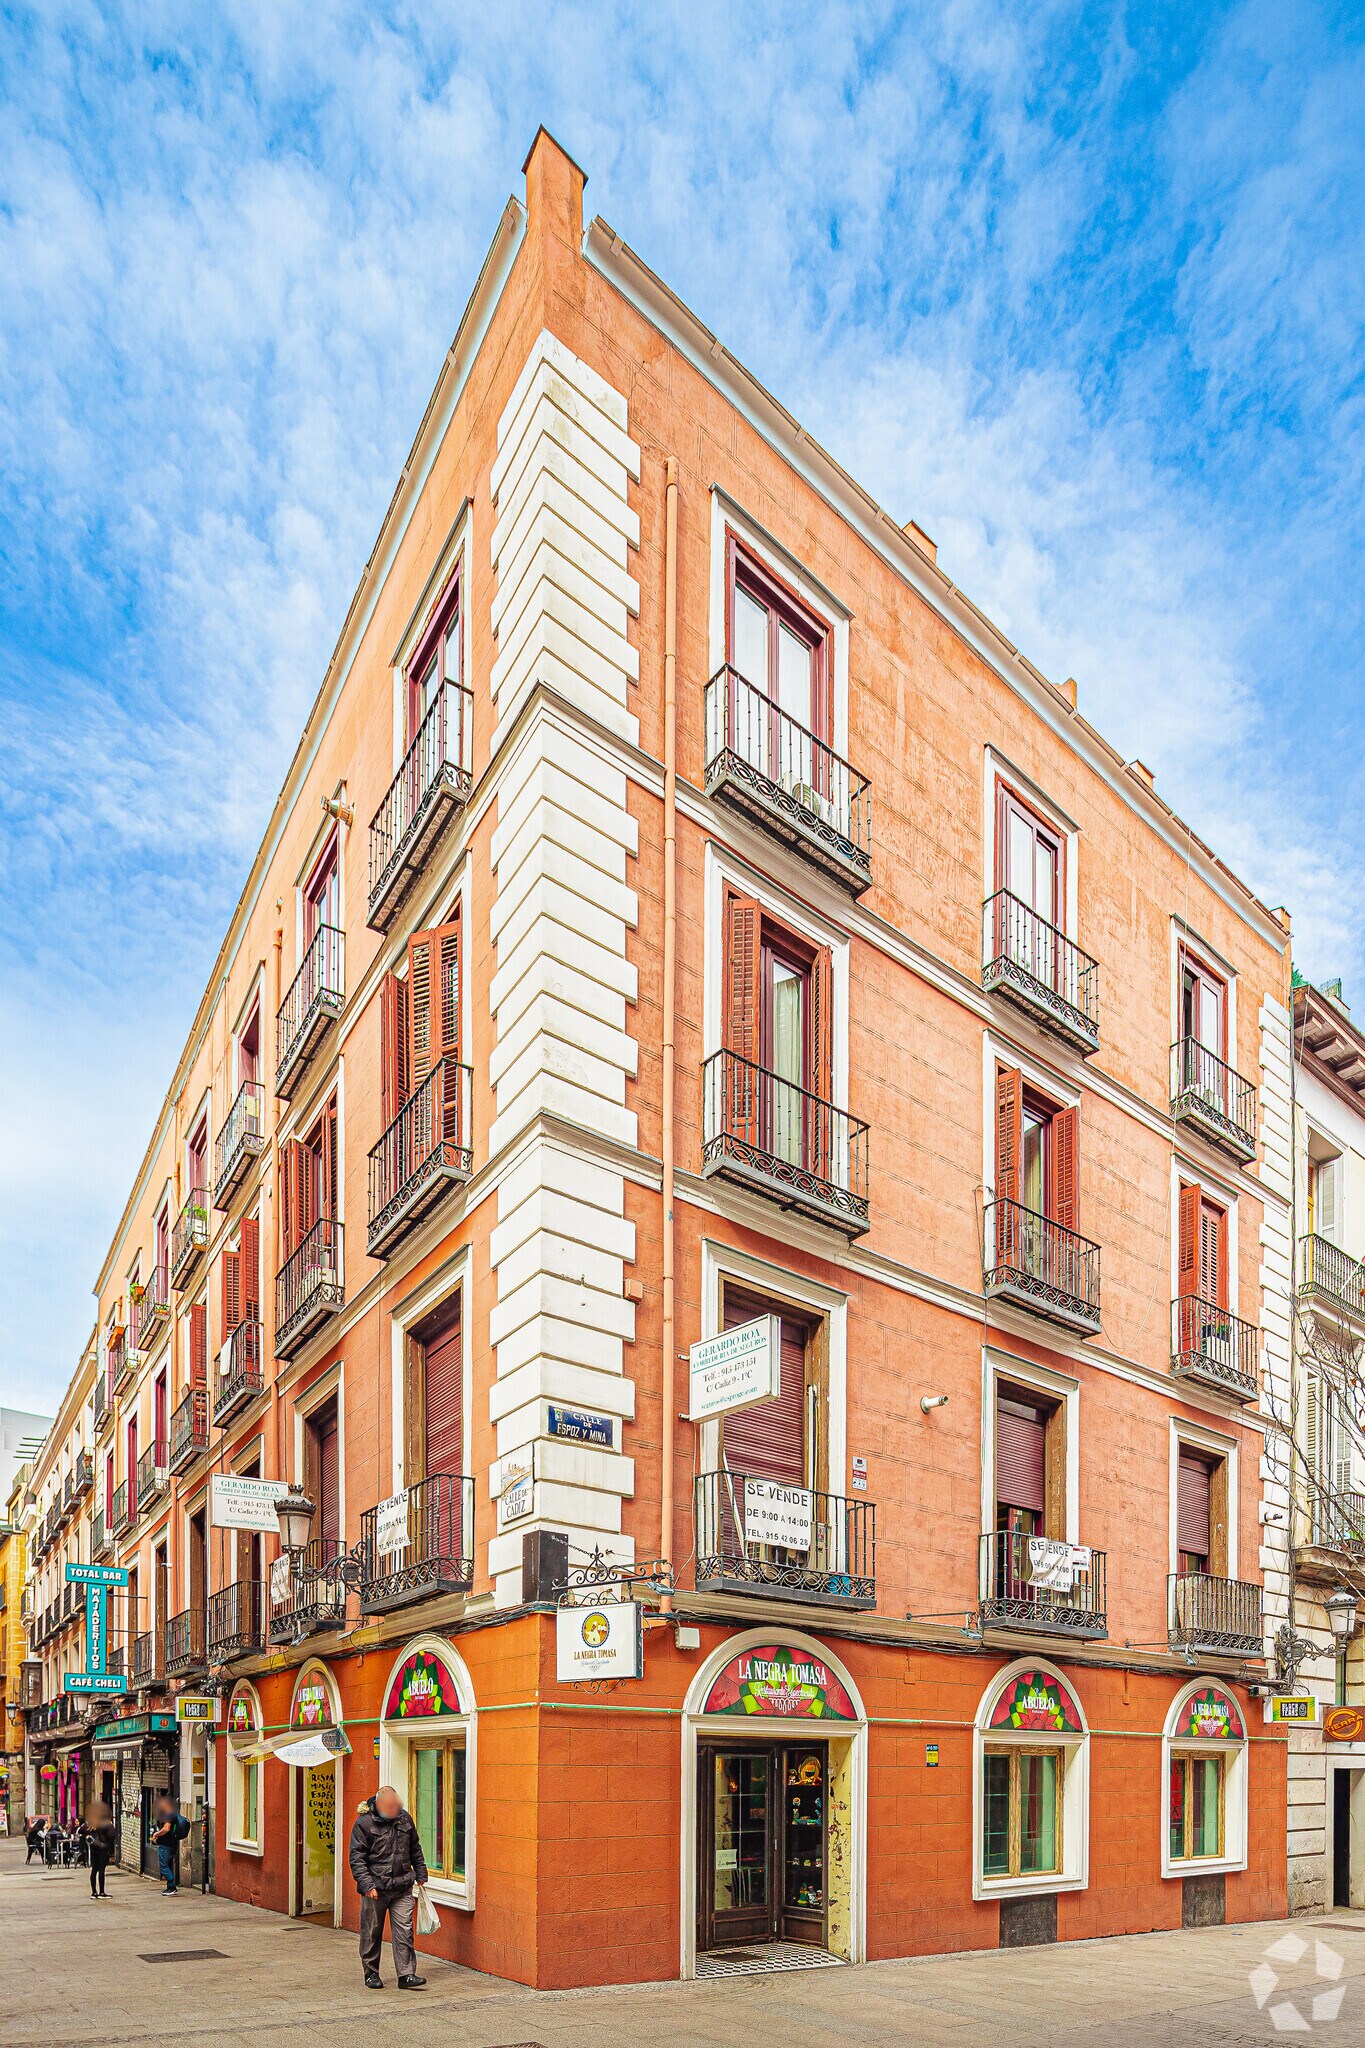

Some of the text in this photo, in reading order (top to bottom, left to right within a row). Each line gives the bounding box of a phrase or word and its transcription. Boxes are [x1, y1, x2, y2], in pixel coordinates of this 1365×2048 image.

[698, 1328, 760, 1358] GERARDO ROA
[730, 1348, 738, 1356] DE
[739, 1337, 767, 1352] SEGUROS
[721, 1367, 732, 1376] 915
[734, 1361, 745, 1372] 473
[746, 1356, 756, 1367] 151
[732, 1376, 736, 1384] 9
[572, 1412, 602, 1426] CALLE
[557, 1423, 606, 1443] ESPOZ Y MINA
[221, 1480, 261, 1491] GERARDO
[379, 1490, 408, 1514] SE VENDE
[505, 1488, 528, 1506] CALLE DE
[747, 1483, 808, 1507] SE VENDE
[506, 1500, 526, 1518] CADIZ
[747, 1508, 809, 1528] DE 9:00 A 14:00
[747, 1528, 764, 1538] TEL.
[766, 1532, 779, 1540] 915
[789, 1536, 798, 1545] 06
[1030, 1541, 1045, 1551] SE
[70, 1568, 122, 1580] TOTAL BAR
[92, 1588, 100, 1669] MAJADERITOS
[574, 1648, 617, 1660] LA NEGRA TOMASA
[738, 1660, 828, 1685] LA NEGRA TOMASA
[70, 1677, 121, 1688] CAFÉ CHELI
[409, 1677, 433, 1696] ABUELO
[1022, 1695, 1055, 1710] ABUELO
[1191, 1703, 1196, 1715] LA
[1326, 1714, 1364, 1731] TIERRA
[313, 1809, 335, 1819] COCK
